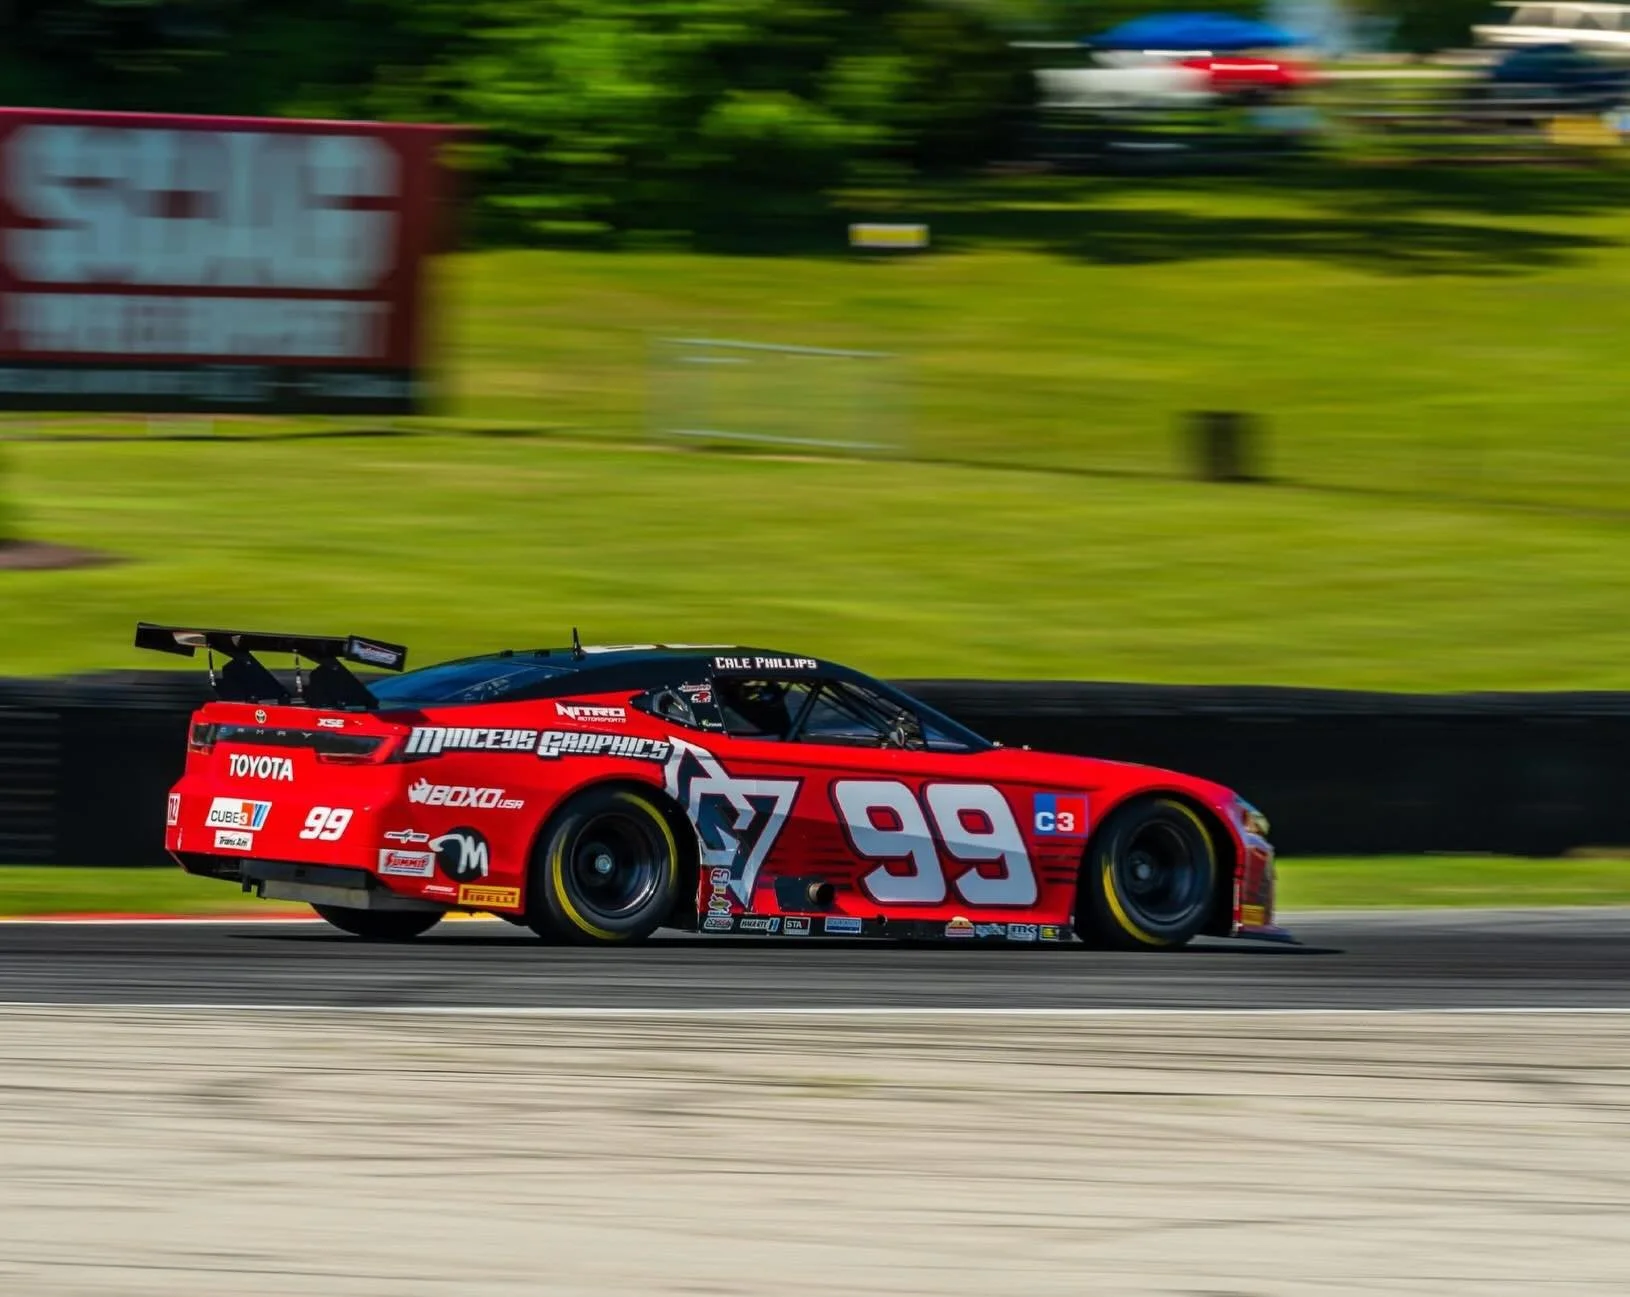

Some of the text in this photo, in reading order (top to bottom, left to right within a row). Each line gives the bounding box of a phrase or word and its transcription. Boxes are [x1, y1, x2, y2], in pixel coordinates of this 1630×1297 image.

[715, 657, 818, 669] CALE PHILLIPS
[555, 702, 626, 720] NITRO
[317, 718, 344, 728] XSE
[404, 726, 670, 759] MINCEYS GRAPHICS
[229, 753, 294, 781] TOYOTA
[426, 785, 524, 809] BOXO USA
[300, 806, 353, 841] 99
[1035, 811, 1075, 831] C3
[834, 779, 1038, 905] 99
[463, 888, 516, 903] PIRELLI
